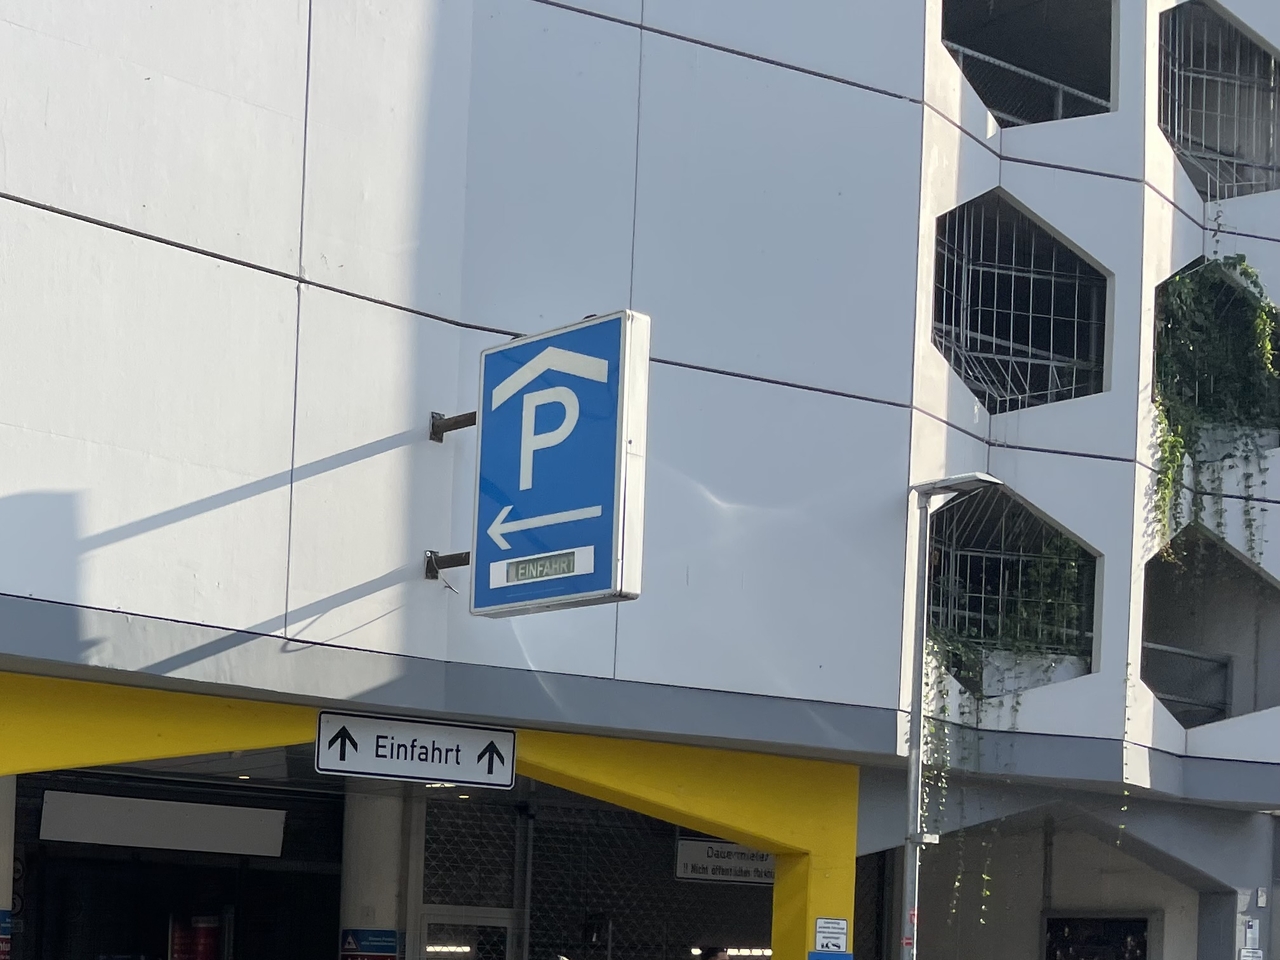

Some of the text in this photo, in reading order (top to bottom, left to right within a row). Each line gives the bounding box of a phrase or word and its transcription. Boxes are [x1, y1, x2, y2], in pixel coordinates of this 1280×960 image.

[519, 386, 580, 491] P
[517, 556, 576, 579] EINFAHRT
[374, 734, 461, 766] Einfahrt
